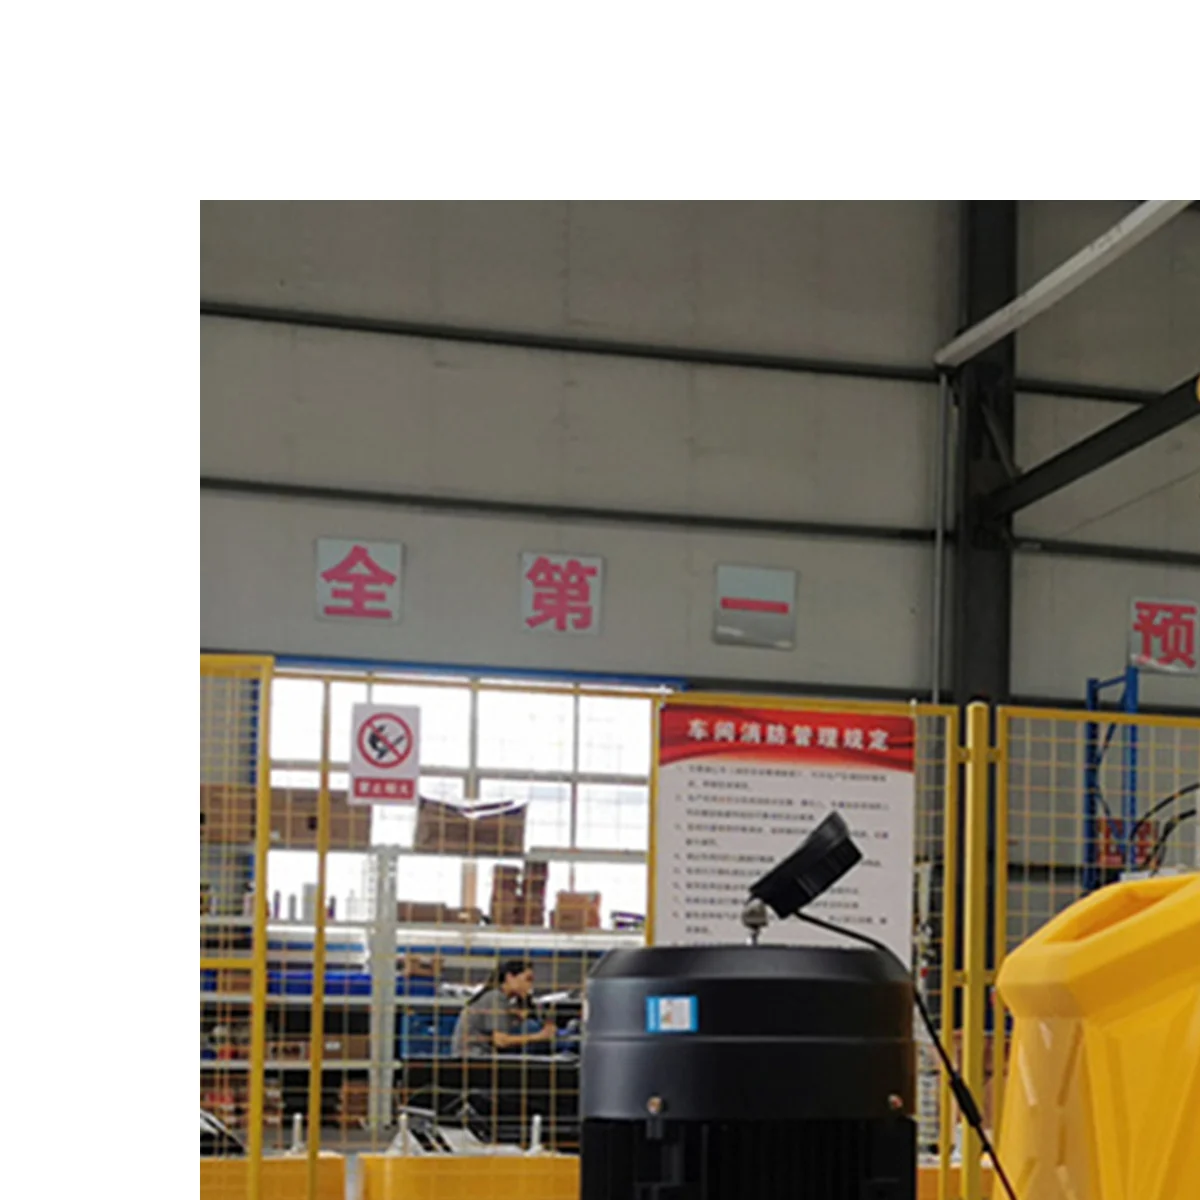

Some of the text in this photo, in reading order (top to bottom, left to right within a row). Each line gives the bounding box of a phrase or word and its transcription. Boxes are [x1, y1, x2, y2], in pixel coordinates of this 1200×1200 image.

[321, 544, 397, 619] 全
[525, 556, 598, 632] 第
[1133, 601, 1197, 669] 预
